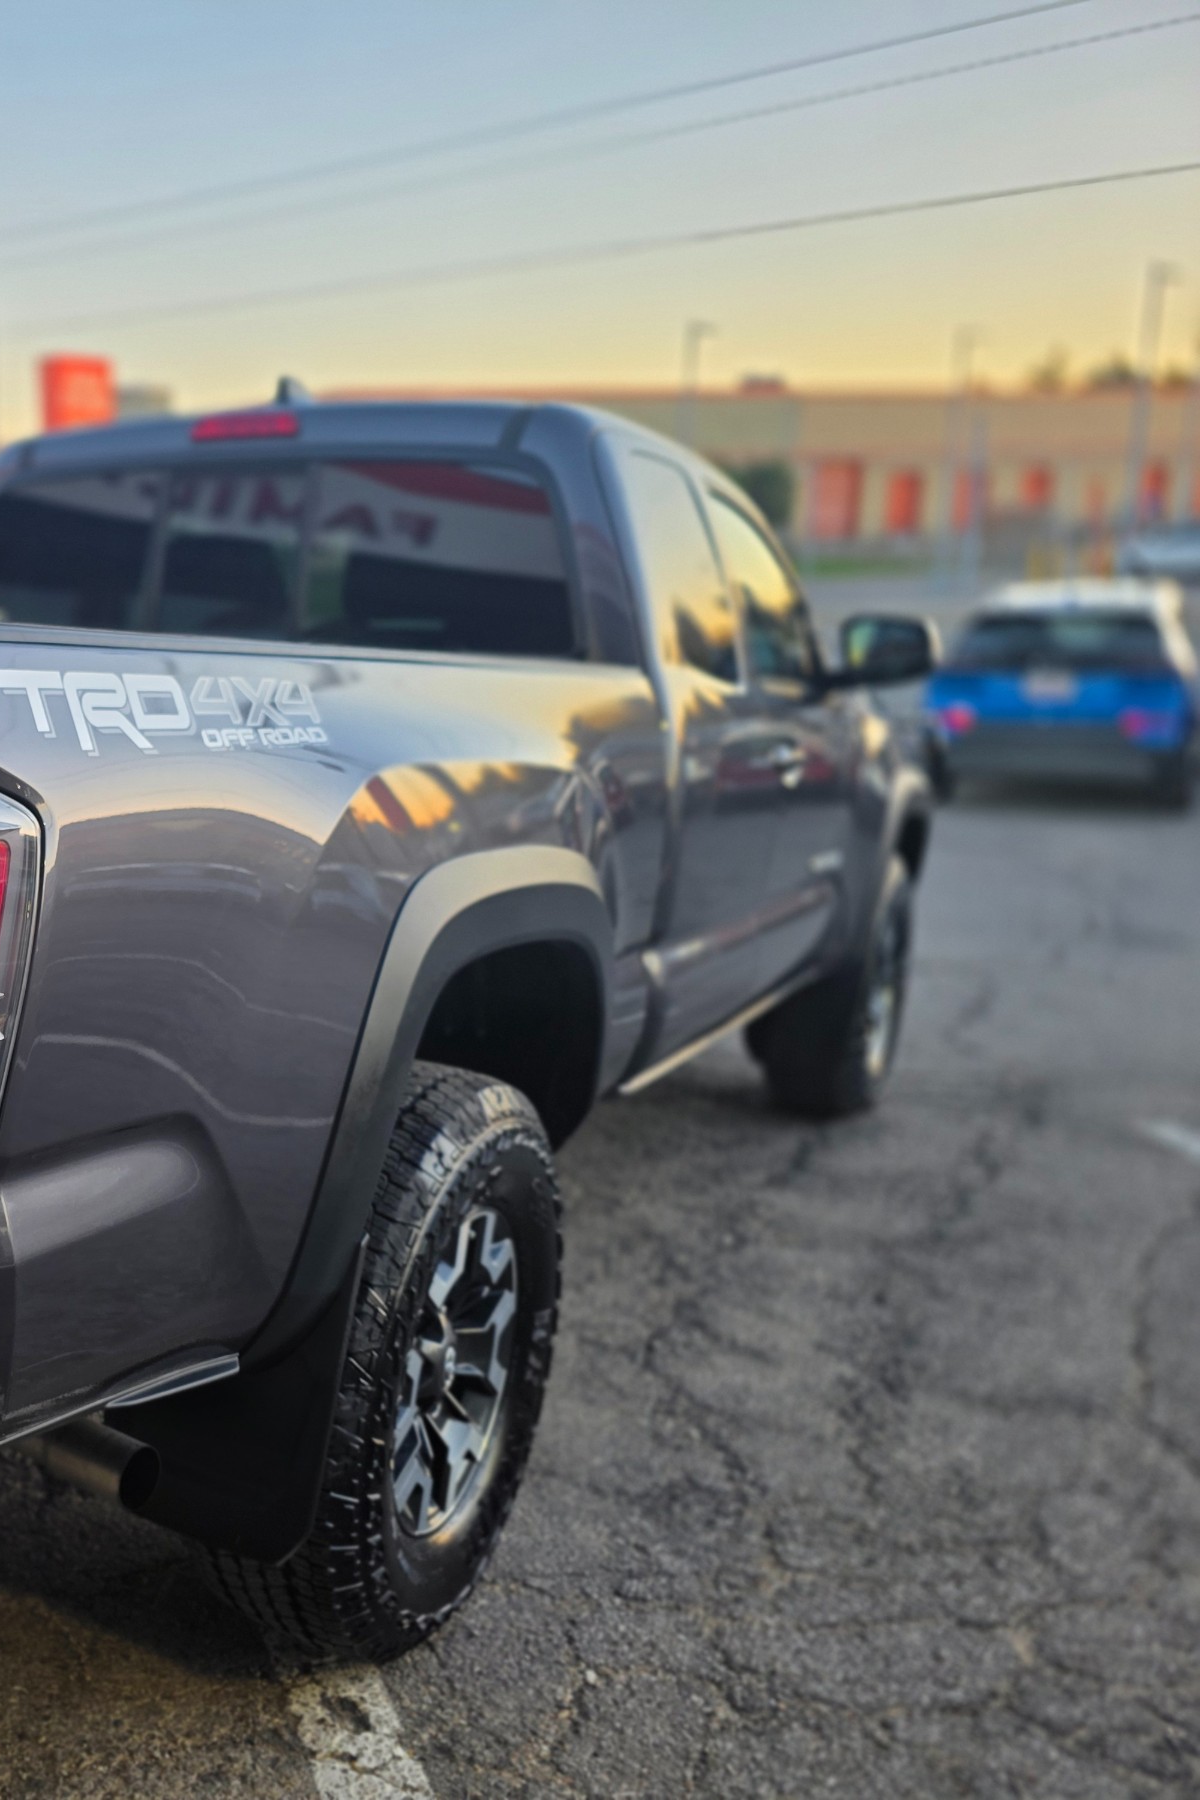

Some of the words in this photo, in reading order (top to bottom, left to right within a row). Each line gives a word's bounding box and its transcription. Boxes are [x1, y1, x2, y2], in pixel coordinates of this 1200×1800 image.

[189, 676, 321, 727] 4X4
[202, 728, 252, 751] OFF
[258, 727, 332, 750] ROAD
